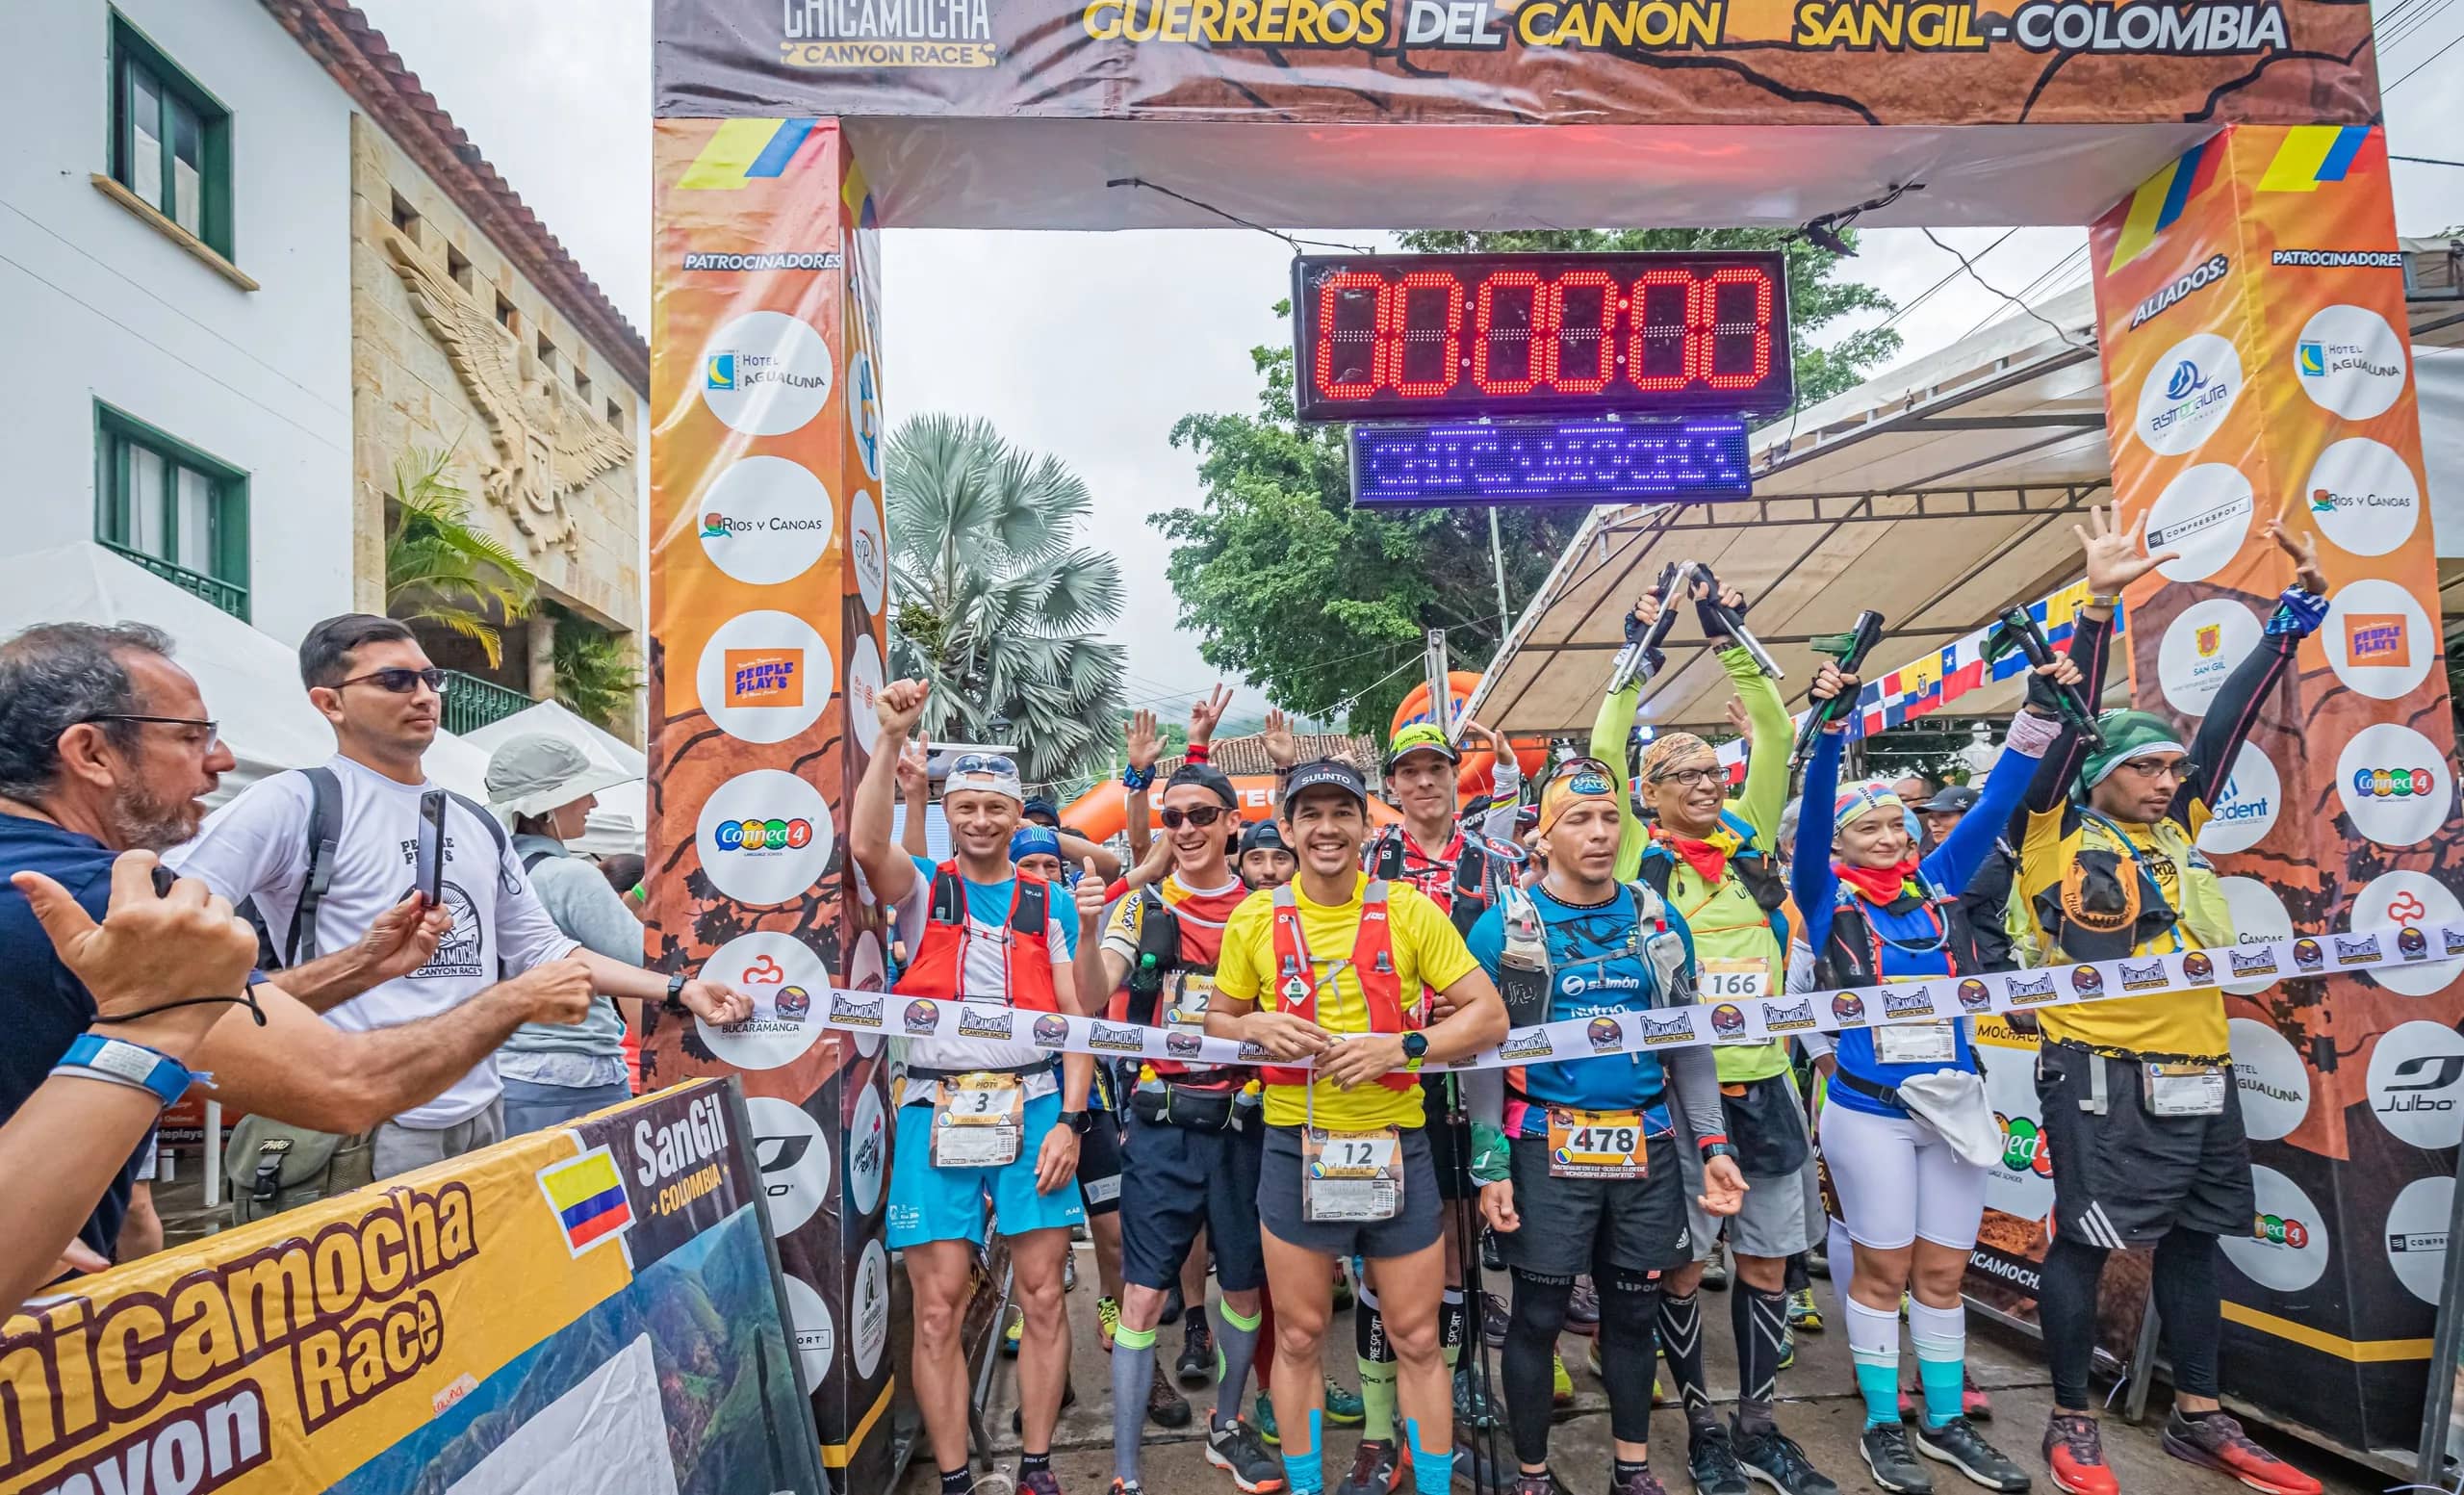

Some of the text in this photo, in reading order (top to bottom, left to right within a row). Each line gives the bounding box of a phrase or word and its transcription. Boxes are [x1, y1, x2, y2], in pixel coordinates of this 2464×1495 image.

[783, 0, 990, 39] CHICAMOCHA
[1083, 0, 1387, 45] GUERREROS
[1404, 1, 1502, 45] DEL
[804, 44, 974, 64] CANYON RACE
[683, 253, 842, 271] PATROCINADORES
[2130, 257, 2227, 328] ALIADOS:
[1315, 267, 1773, 400] 00:00:00
[2329, 344, 2364, 355] HOTEL
[742, 353, 780, 367] HOTEL
[2332, 358, 2400, 377] AGUALUNA
[744, 371, 826, 389] AGUALUNA
[2367, 493, 2411, 507] CANOAS
[722, 516, 822, 531] RIOS Y CANOAS
[2354, 626, 2400, 644] PEOPLE
[735, 662, 794, 683] PEOPLE
[735, 676, 787, 695] PLAY'S
[1300, 772, 1351, 786] SUUNTO
[2358, 775, 2428, 789] Connect 4
[721, 825, 806, 844] Connect 4
[417, 967, 458, 976] CANYON
[1713, 974, 1757, 994] 166
[831, 992, 884, 1019] CHICAMOCHA
[1194, 993, 1210, 1012] 2
[721, 1022, 801, 1034] BUCARAMANGA
[962, 1007, 1014, 1033] CHICAMOCHA
[1091, 1021, 1142, 1044] CHICAMOCHA
[2234, 1063, 2258, 1075] OTEL
[2235, 1078, 2303, 1102] GUALUNA
[974, 1093, 989, 1113] 3
[2376, 1094, 2453, 1112] Julbo
[634, 1093, 729, 1187] SanGil
[1574, 1128, 1634, 1152] 478
[1344, 1143, 1373, 1165] 12
[659, 1163, 723, 1217] COLOMBIA
[2409, 1236, 2450, 1248] COMPR
[300, 1298, 439, 1422] Race
